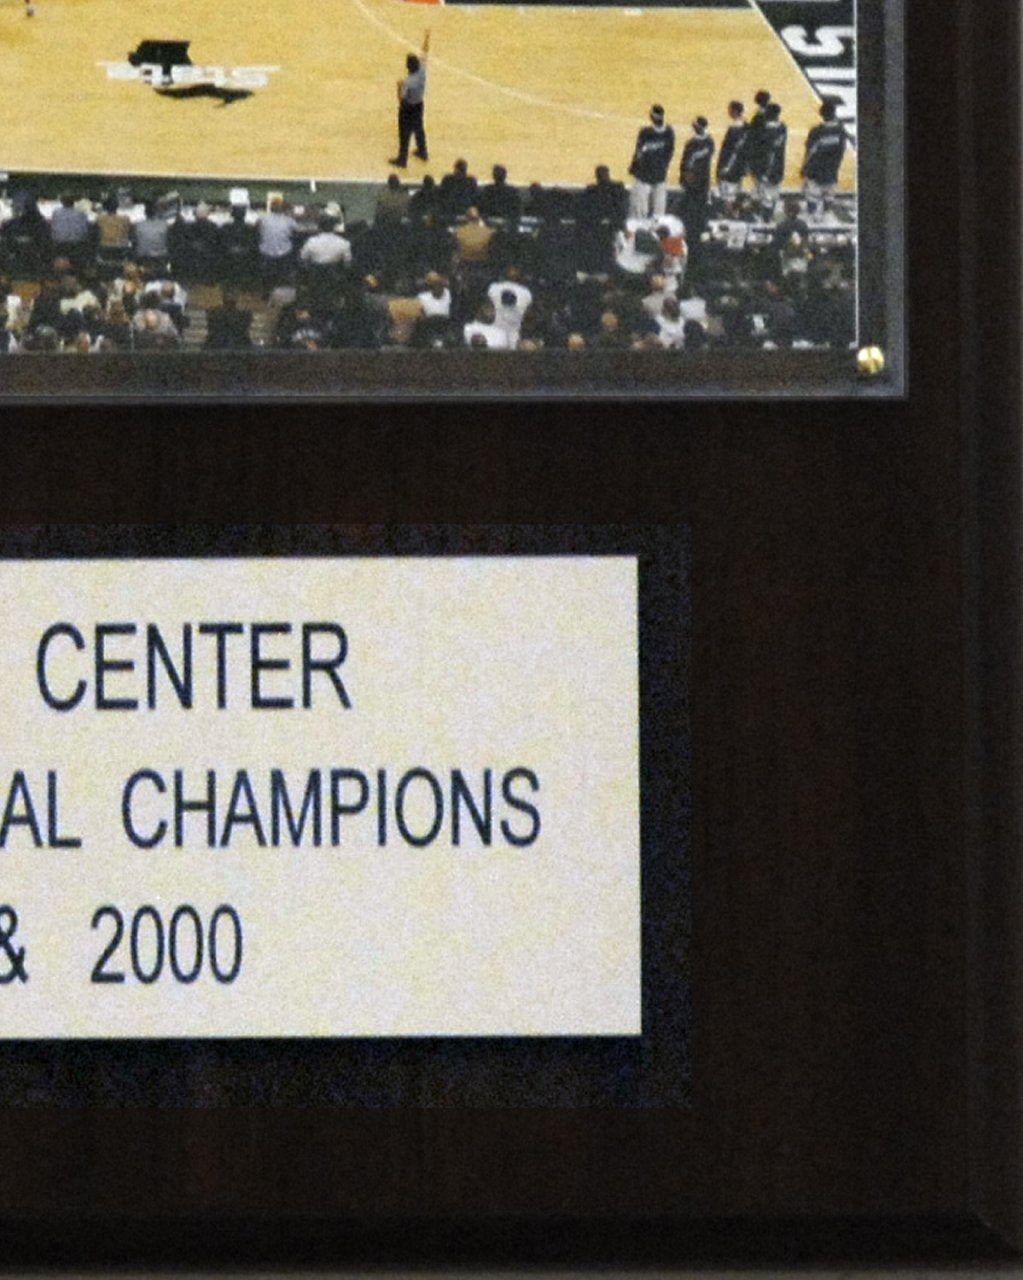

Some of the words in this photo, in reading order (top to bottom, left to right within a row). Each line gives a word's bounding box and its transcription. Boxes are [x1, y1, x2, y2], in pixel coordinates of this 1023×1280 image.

[36, 622, 351, 712] CENTER
[121, 766, 541, 850] CHAMPIONS
[90, 904, 243, 985] 2000
